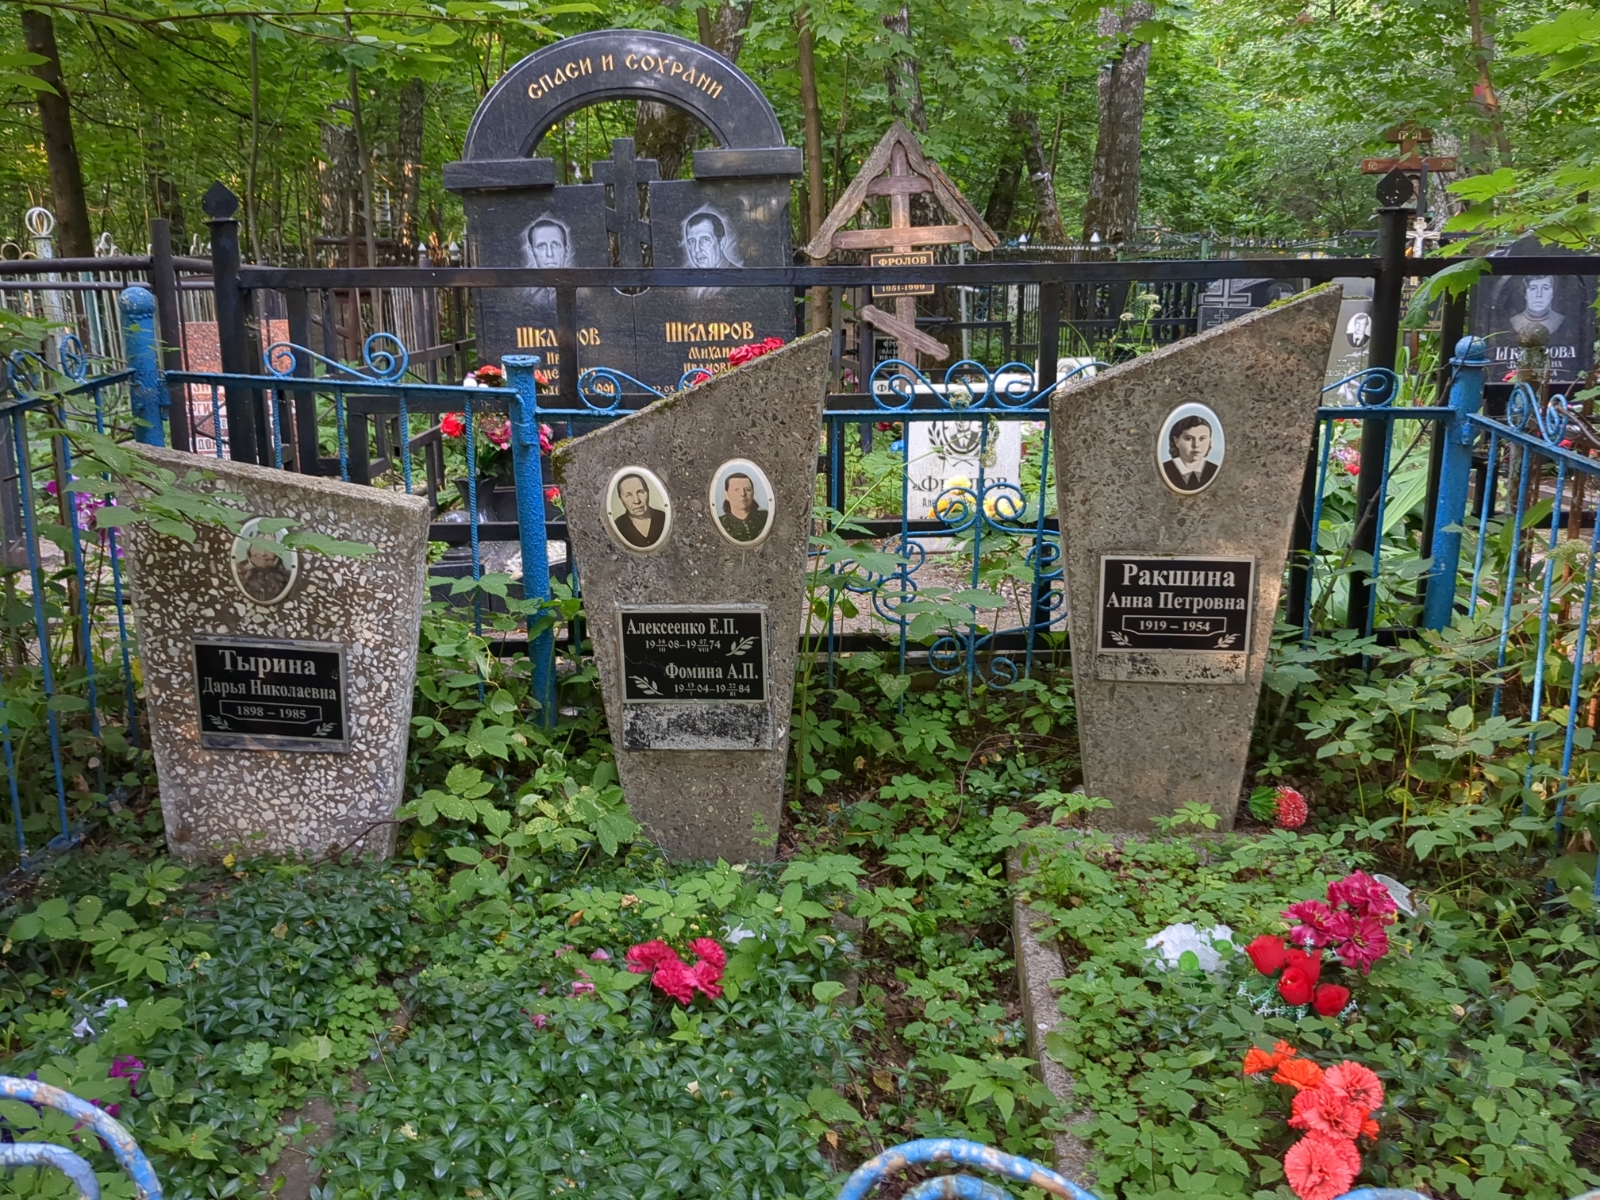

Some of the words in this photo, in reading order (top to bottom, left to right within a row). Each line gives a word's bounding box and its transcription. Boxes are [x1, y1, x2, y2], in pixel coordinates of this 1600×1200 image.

[527, 57, 593, 99] СПАСИ
[601, 54, 614, 72] И
[625, 53, 724, 99] СОХРАНИ
[878, 256, 927, 267] ФРОЛОВ
[516, 327, 601, 348] ШКЛОВ
[665, 321, 755, 343] ШКЛЯРОВ
[1121, 563, 1236, 588] Ракшина
[1106, 591, 1153, 608] Анна
[1158, 591, 1246, 614] Петровна
[626, 618, 706, 635] Алексеенко
[708, 618, 739, 635] Е.П.
[1139, 620, 1167, 631] 1919
[1182, 621, 1210, 632] 1954
[218, 649, 318, 679] Тырина
[665, 662, 724, 679] Фомина
[727, 663, 759, 679] А.П.
[202, 676, 247, 698] Дарья
[250, 679, 337, 701] Николаевна
[236, 705, 264, 716] 1898
[279, 708, 307, 719] 1985
